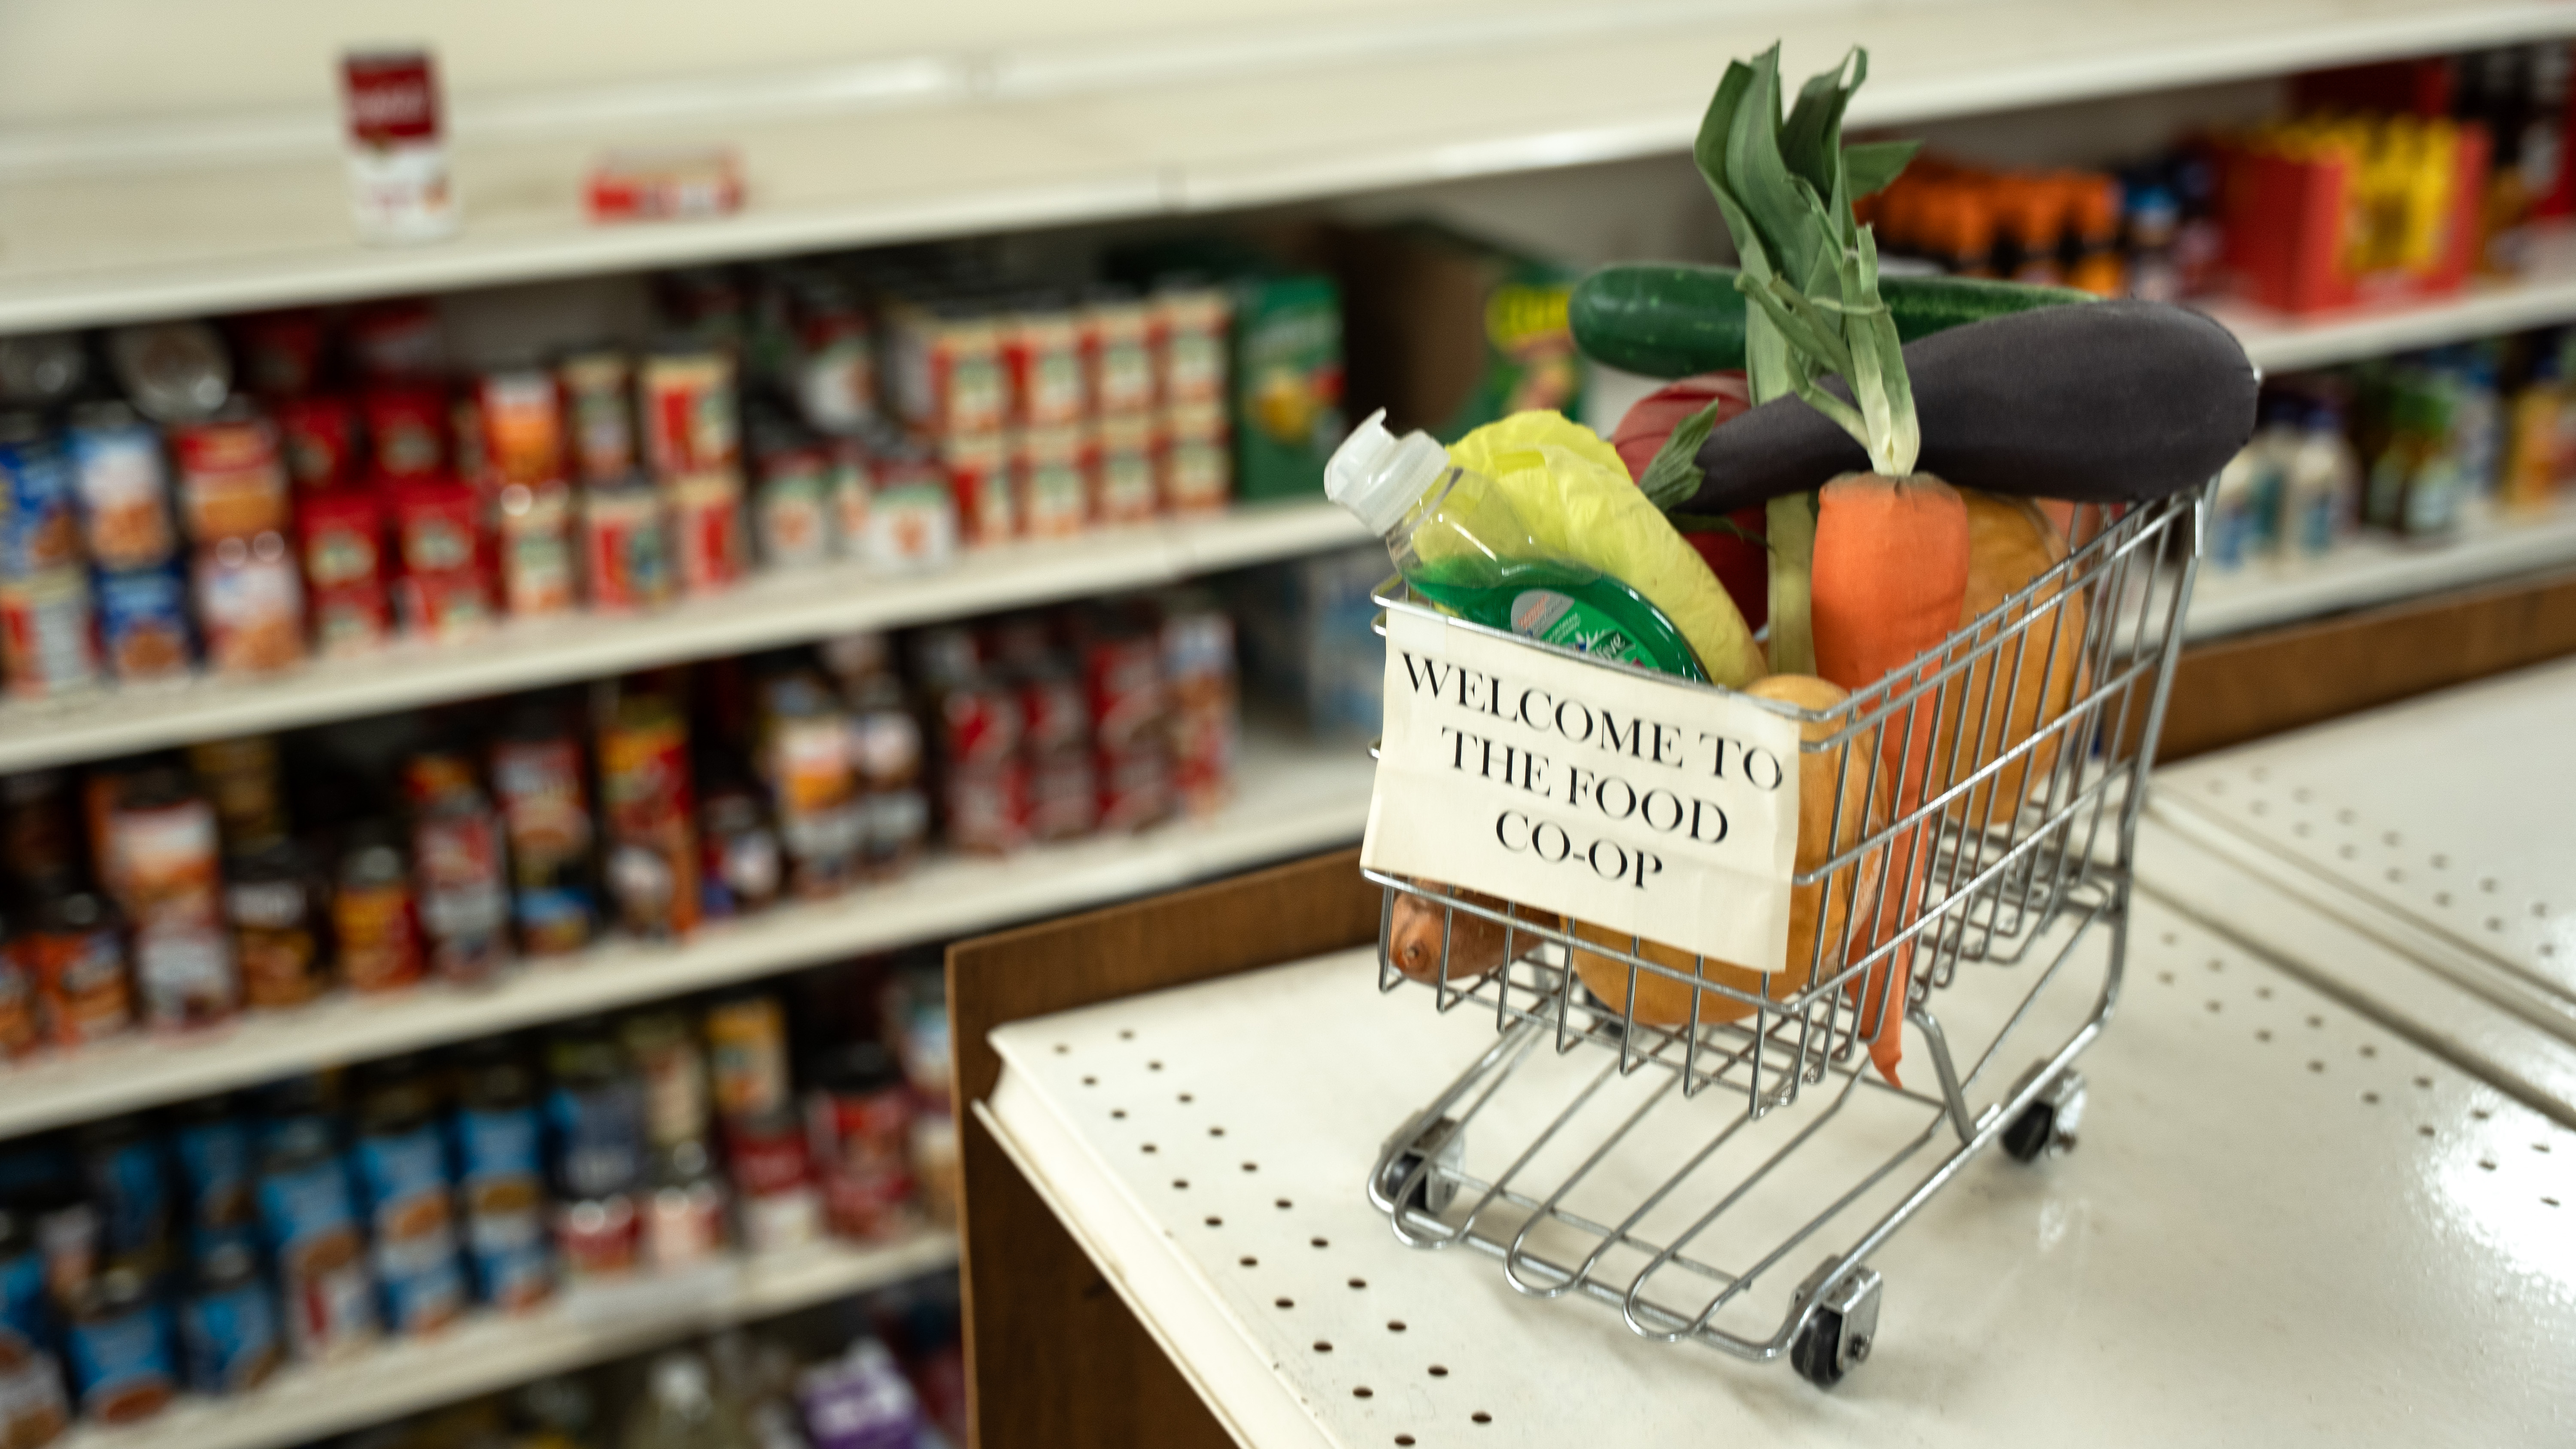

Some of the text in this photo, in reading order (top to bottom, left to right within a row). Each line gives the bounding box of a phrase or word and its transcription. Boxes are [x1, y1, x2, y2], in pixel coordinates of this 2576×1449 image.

[1399, 652, 1783, 791] WELCOME TO
[1441, 727, 1728, 844] THE FOOD
[1496, 810, 1663, 890] CO-OP
